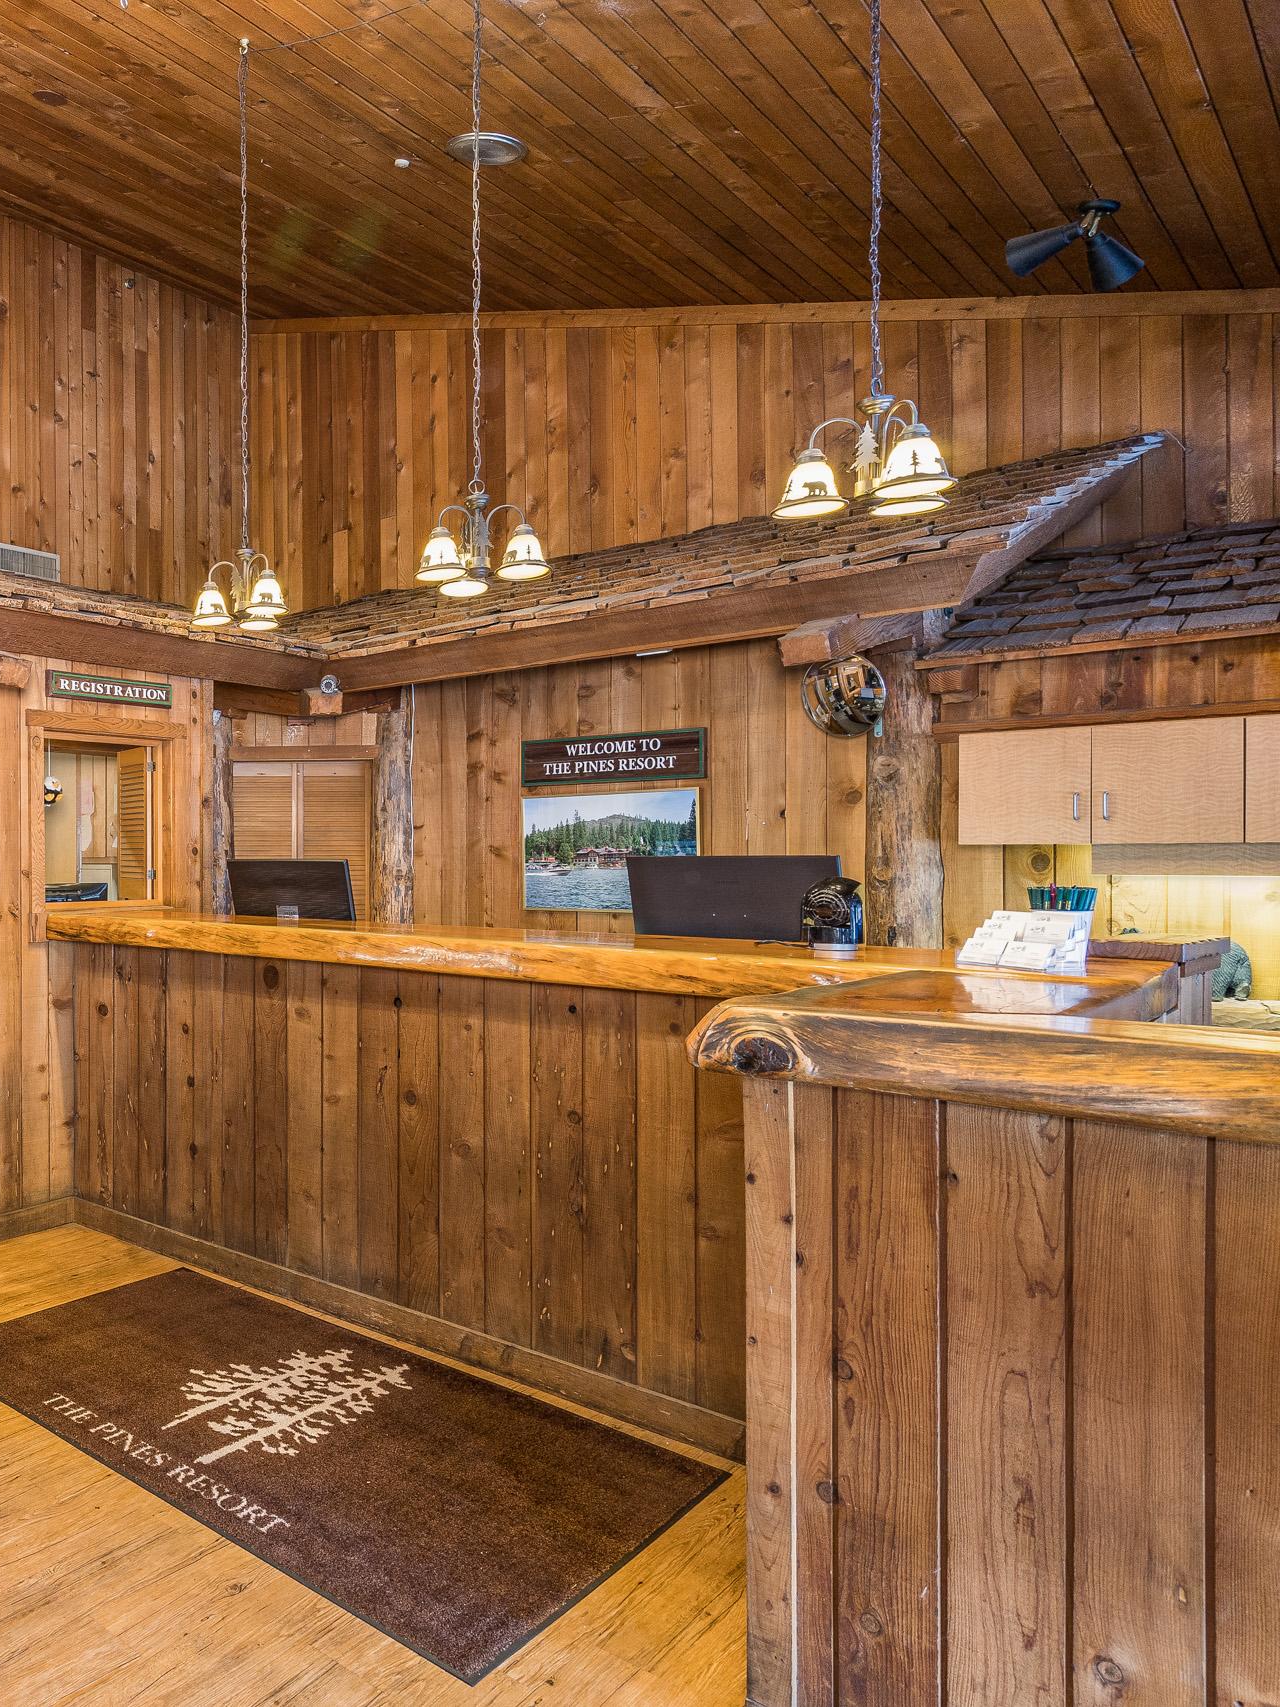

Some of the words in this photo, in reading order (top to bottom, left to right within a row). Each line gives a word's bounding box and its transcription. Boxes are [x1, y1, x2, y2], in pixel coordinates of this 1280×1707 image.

[59, 678, 167, 701] REGISTRATION
[565, 740, 637, 757] WELCOME
[639, 737, 661, 752] TO
[543, 762, 572, 776] THE
[574, 759, 615, 774] PINES
[618, 755, 677, 772] RESORT
[43, 1392, 98, 1424] THE
[89, 1422, 172, 1467] PINES
[167, 1462, 291, 1534] RESORT
